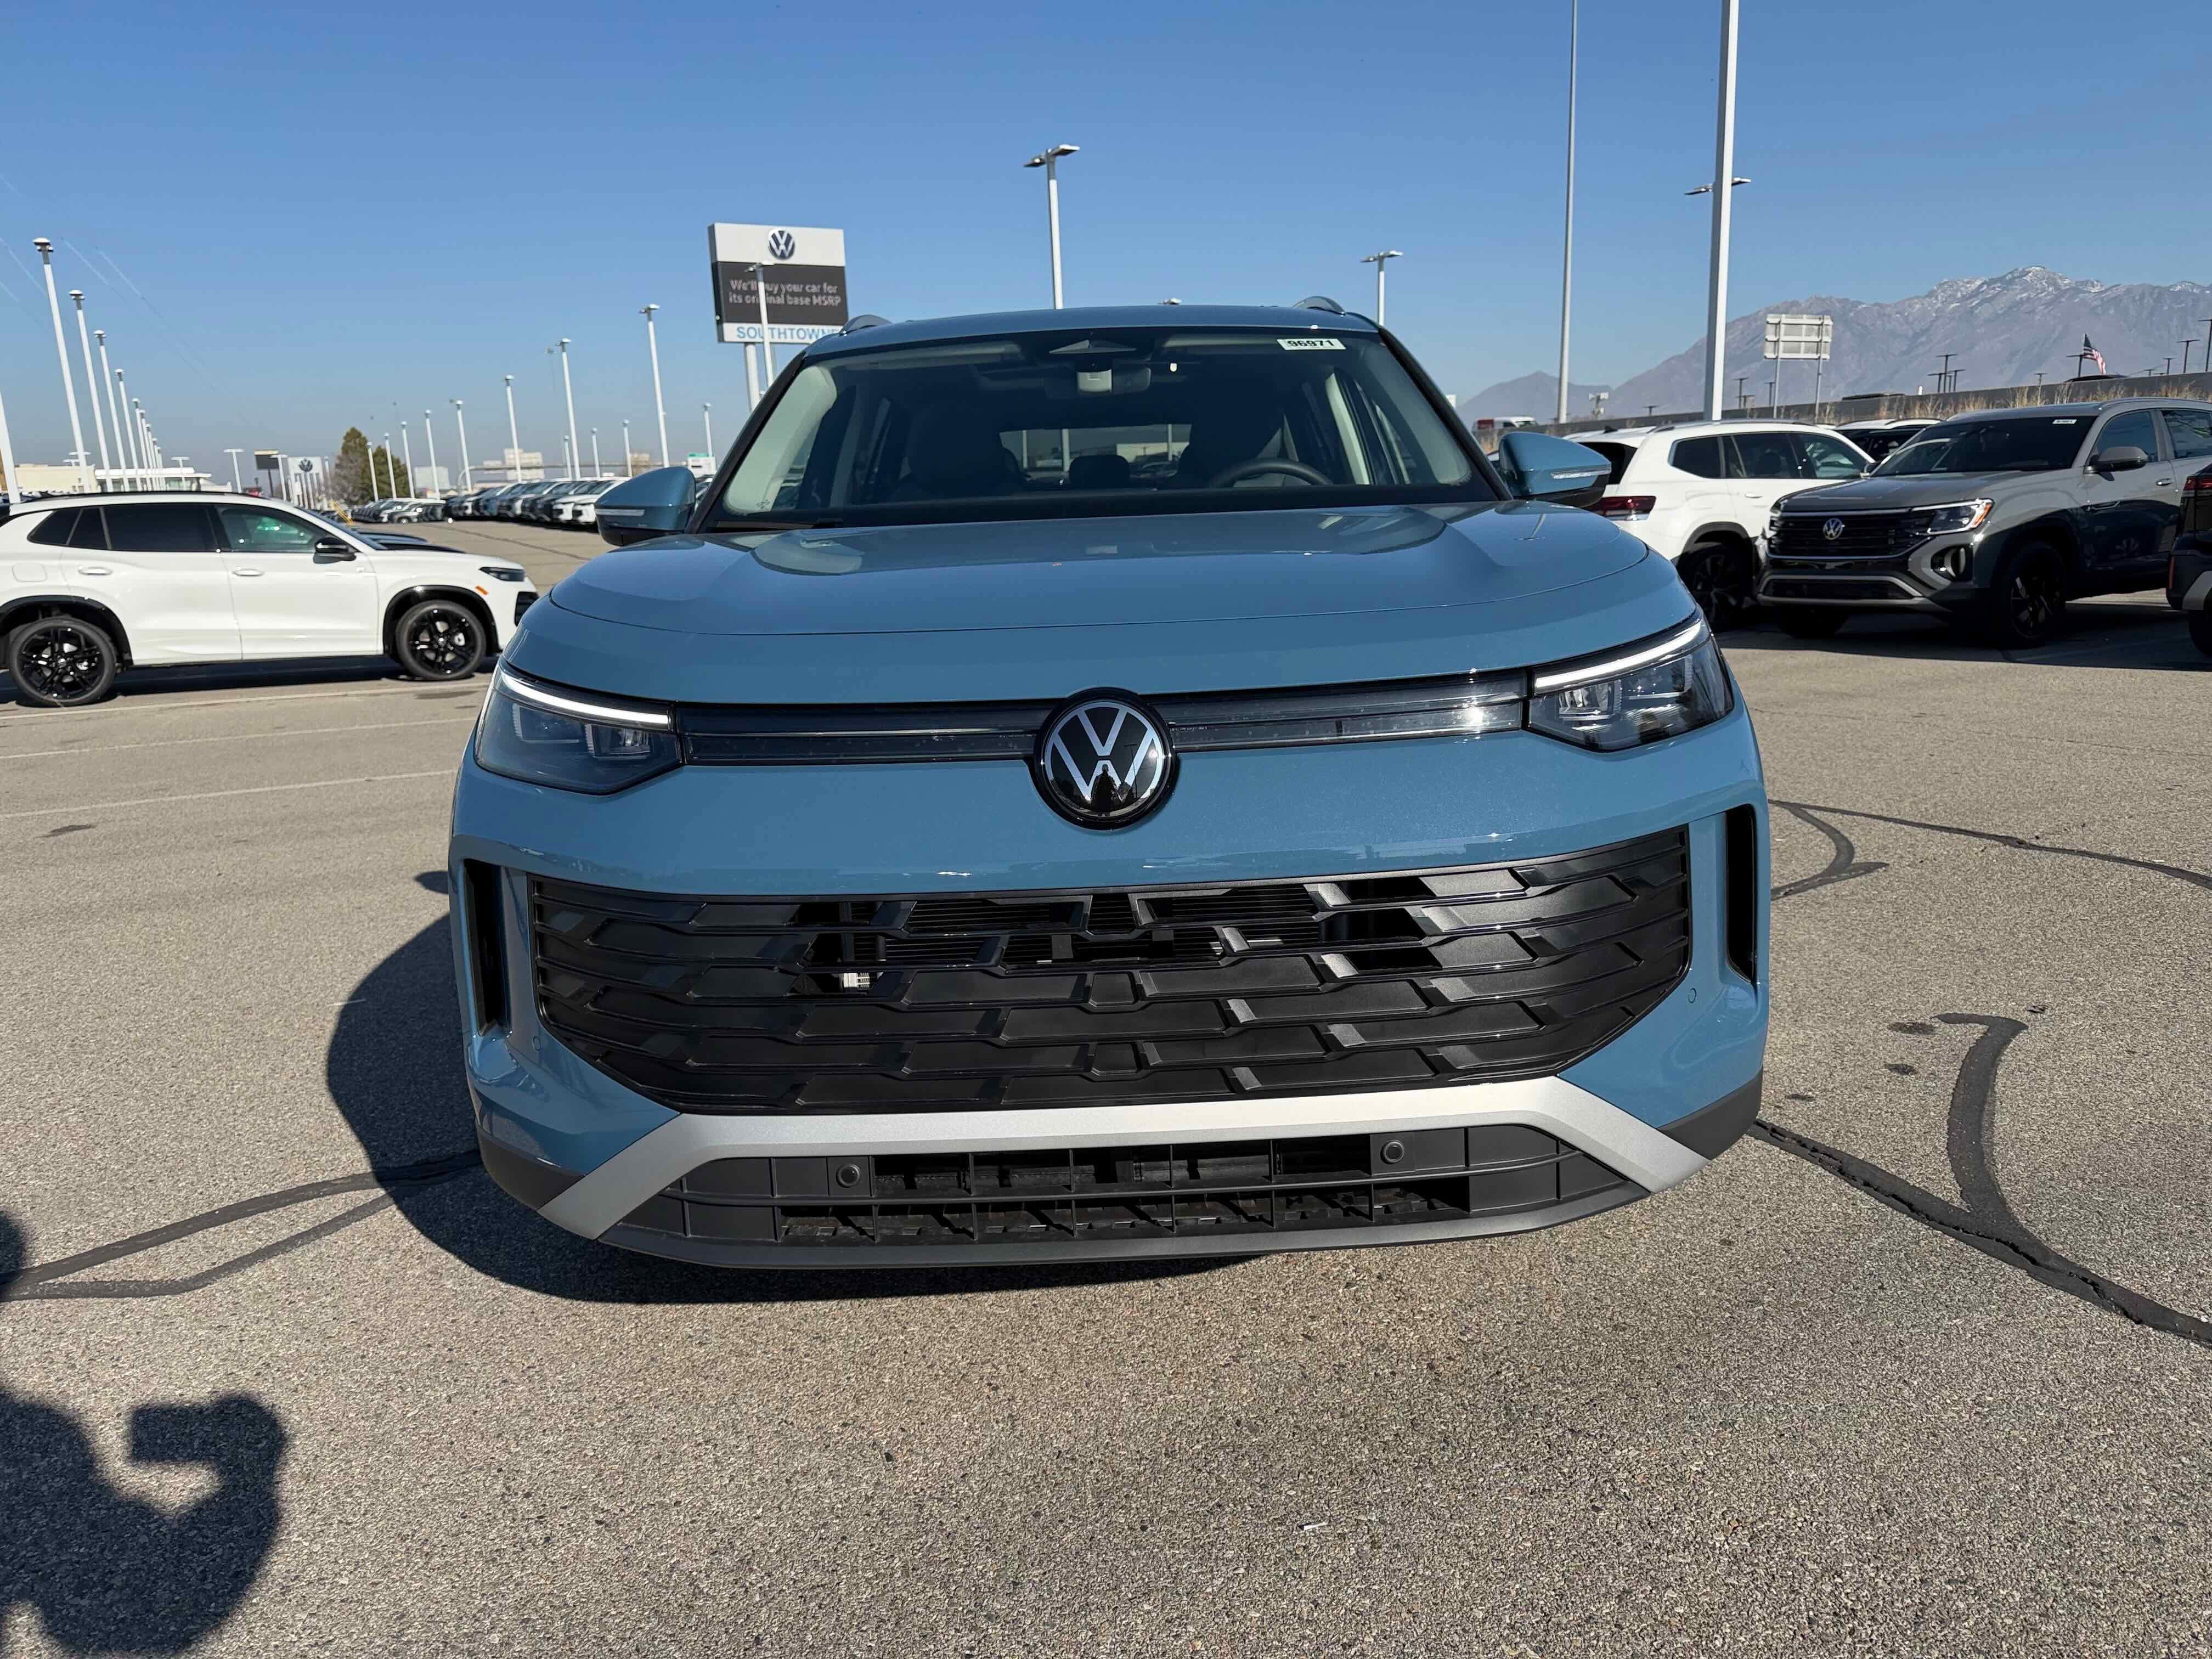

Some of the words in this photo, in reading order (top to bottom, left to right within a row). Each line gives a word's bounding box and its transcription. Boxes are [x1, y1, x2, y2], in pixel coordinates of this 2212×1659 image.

[769, 230, 795, 260] VW
[765, 283, 779, 294] uy
[780, 284, 803, 294] your
[805, 284, 821, 293] car
[823, 281, 838, 294] for
[729, 292, 743, 304] its
[745, 293, 785, 304] oriinal
[786, 294, 811, 306] base
[812, 294, 841, 307] MSRP
[1044, 701, 1165, 817] VW
